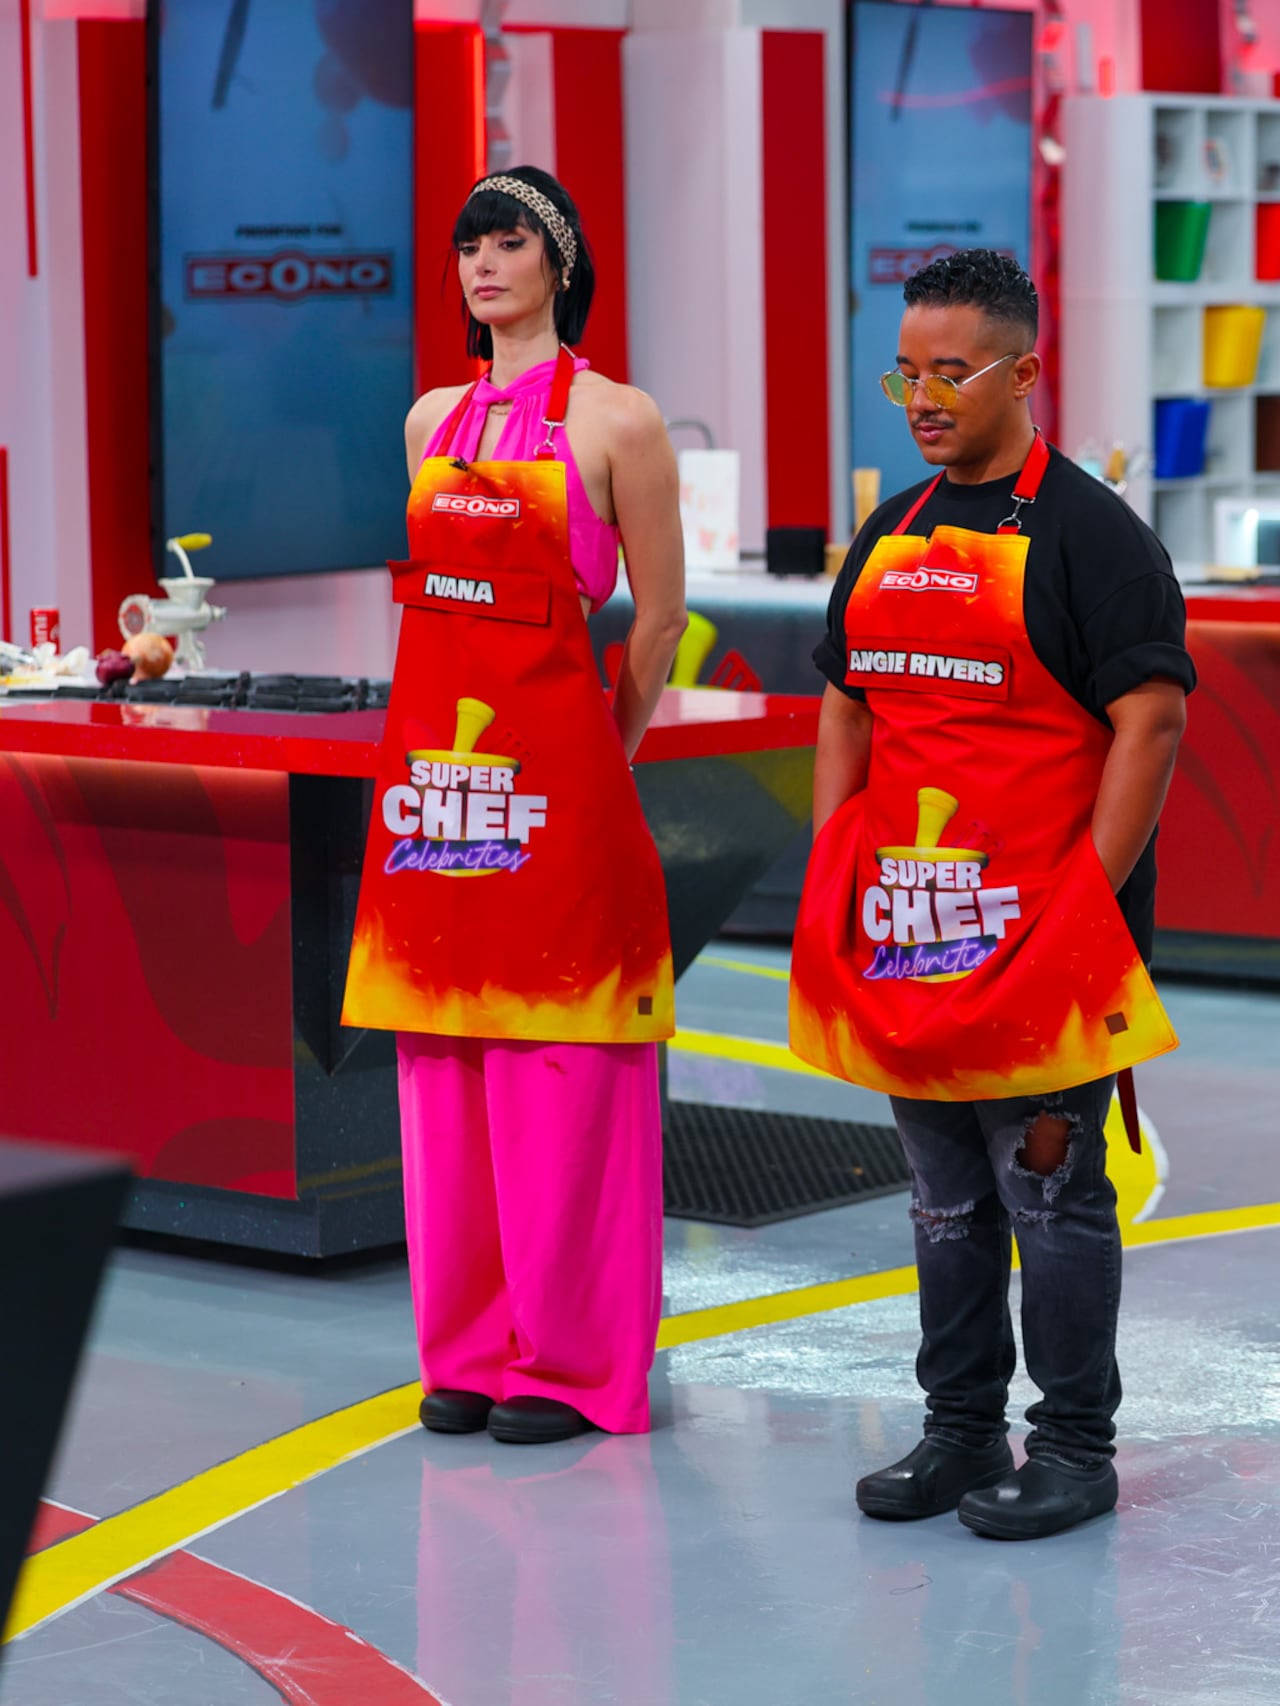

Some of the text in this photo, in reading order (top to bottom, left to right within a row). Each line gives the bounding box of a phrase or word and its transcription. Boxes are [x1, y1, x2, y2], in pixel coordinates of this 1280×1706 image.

[193, 258, 385, 293] ECONO
[435, 498, 516, 514] ECONO
[882, 571, 973, 588] ECONO
[850, 650, 1004, 686] ANGIE RIVERS
[410, 760, 514, 793] SUPER
[382, 784, 548, 844] CHEF
[384, 837, 531, 875] Celebrities
[879, 857, 982, 889] SUPER
[862, 885, 1021, 943] CHEF
